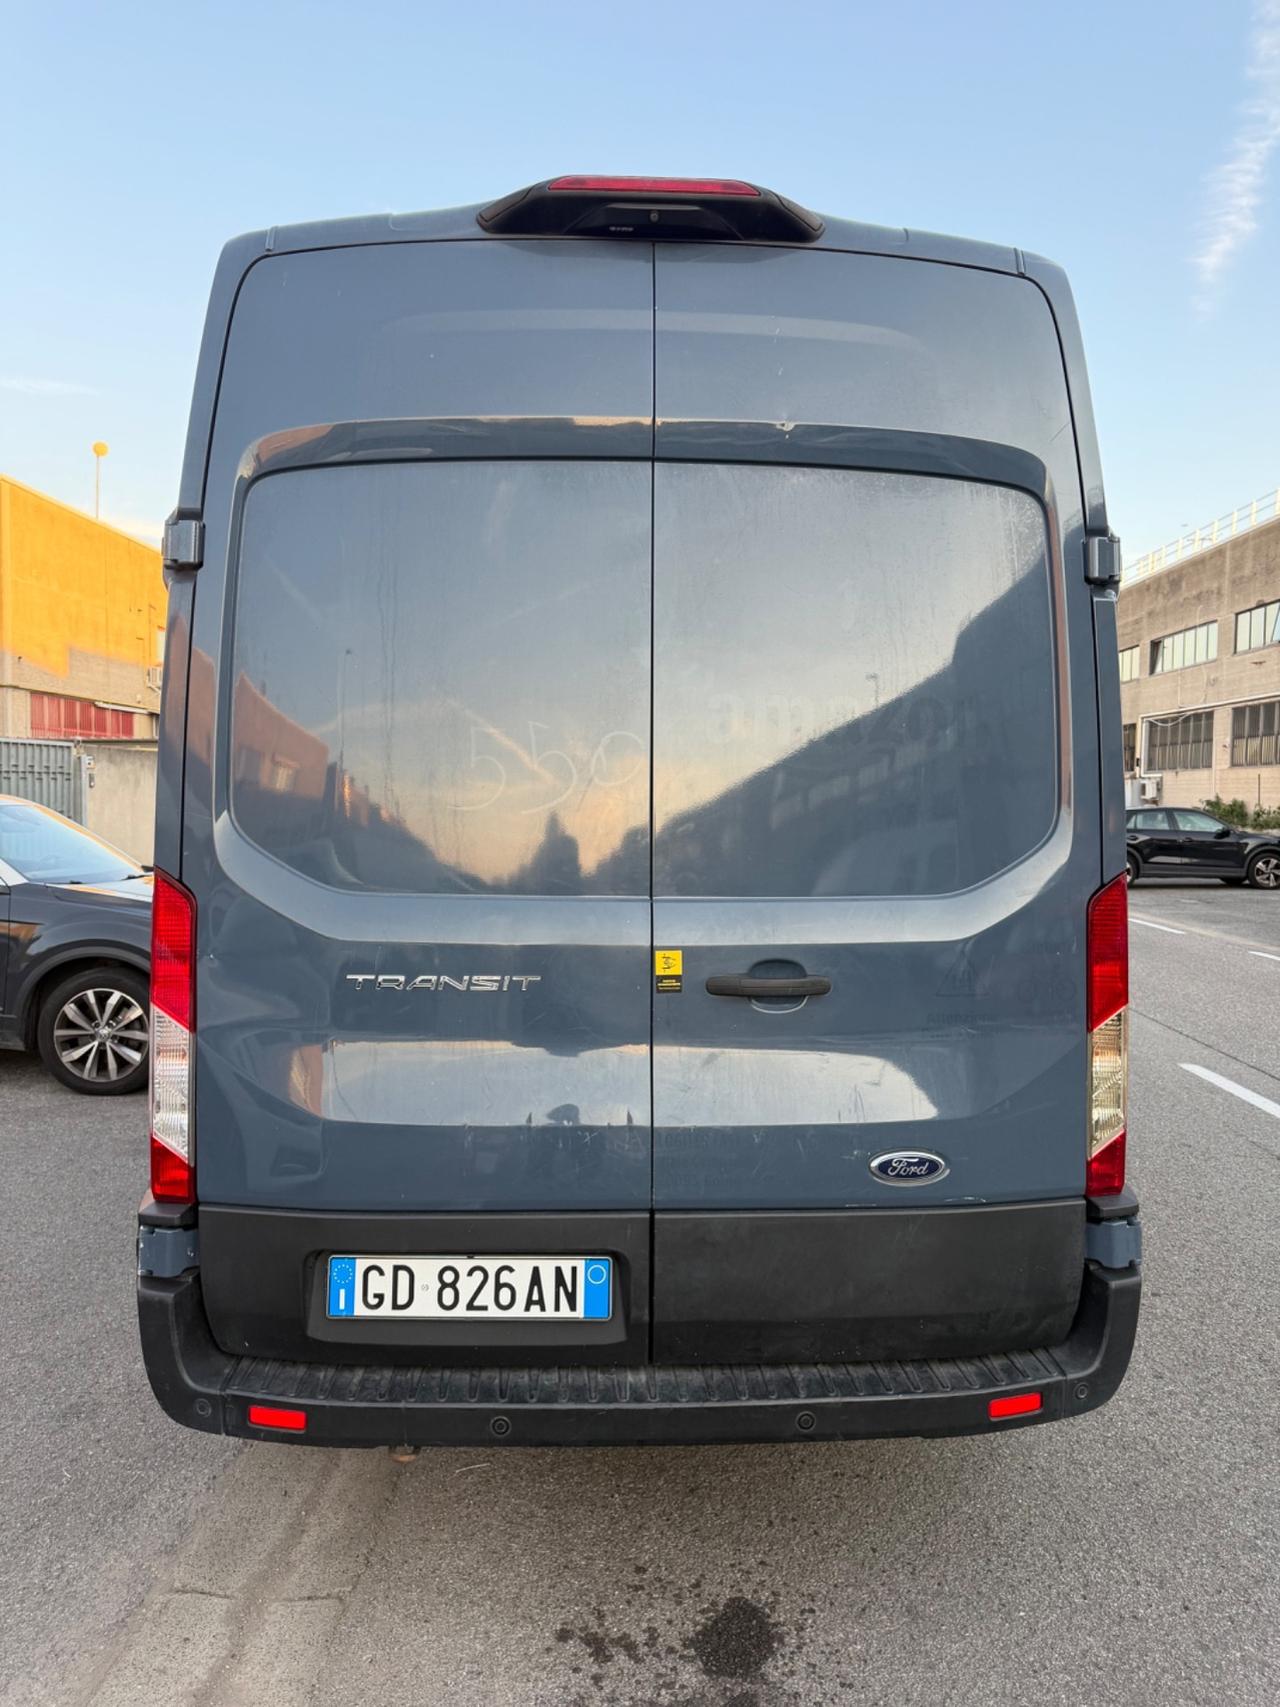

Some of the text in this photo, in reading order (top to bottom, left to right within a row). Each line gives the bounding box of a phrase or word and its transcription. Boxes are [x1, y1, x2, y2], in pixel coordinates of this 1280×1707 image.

[346, 974, 541, 992] TRANSIT
[887, 1157, 930, 1176] Ford
[362, 1264, 578, 1312] GD 826AN
